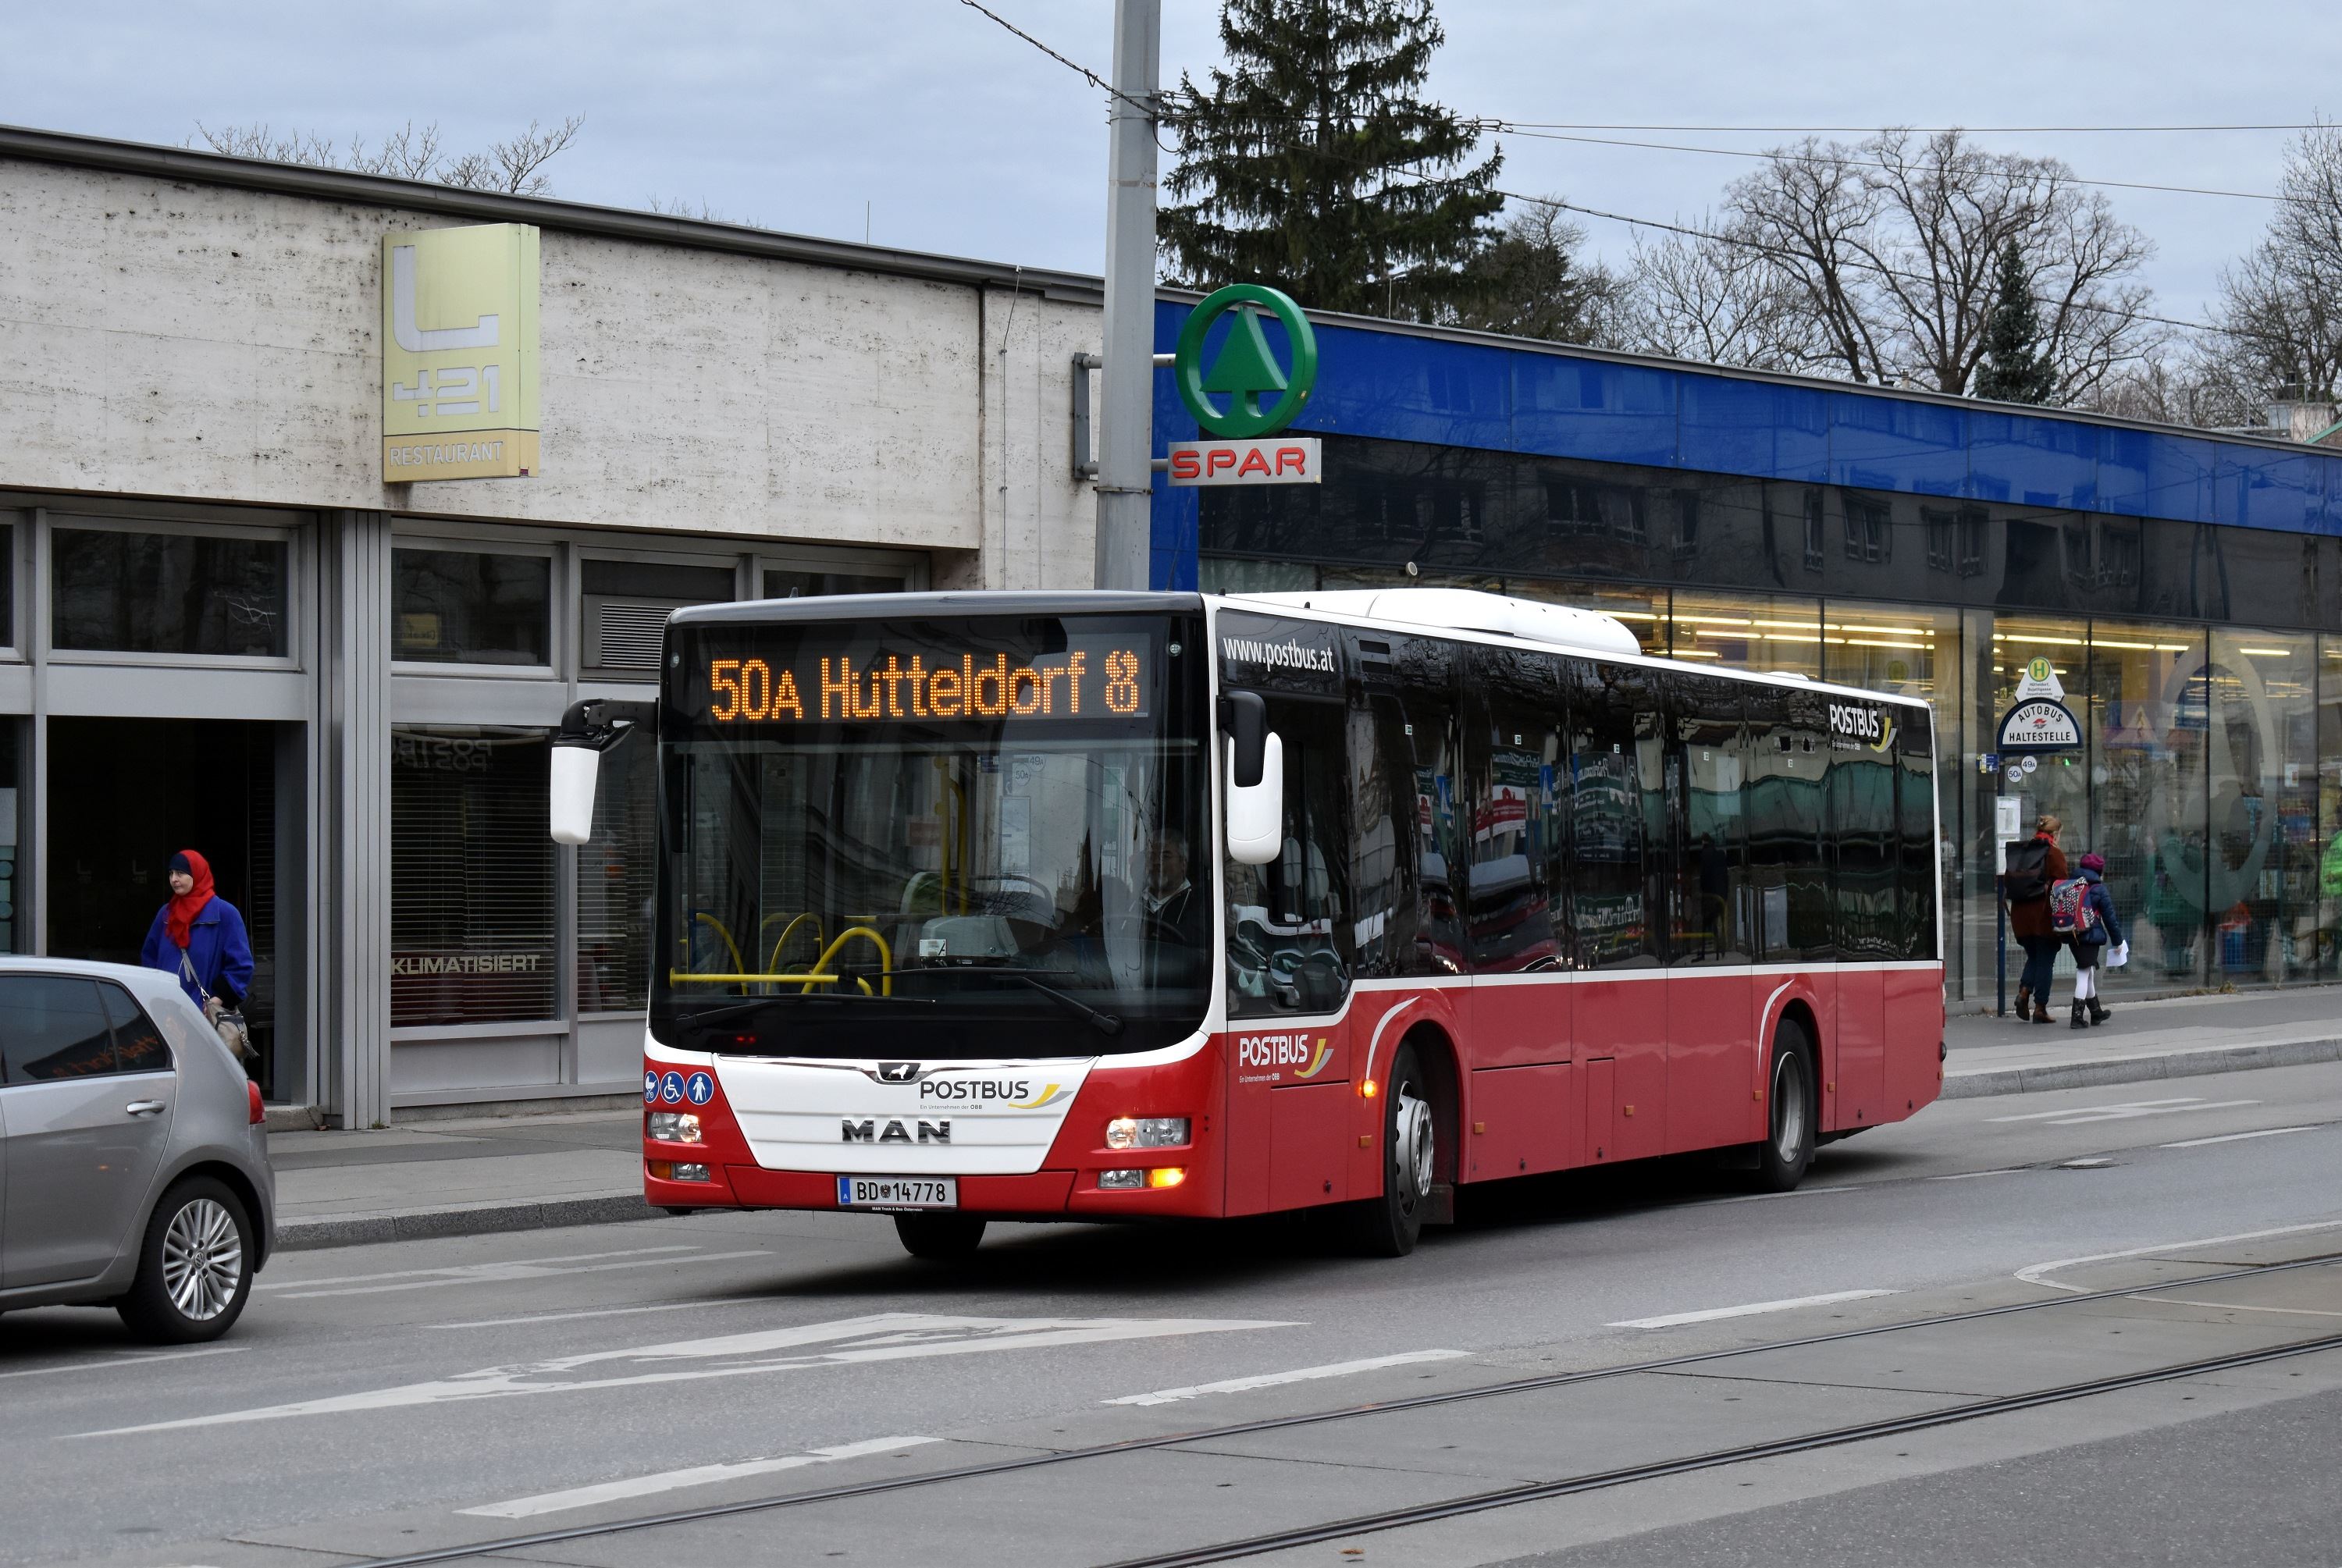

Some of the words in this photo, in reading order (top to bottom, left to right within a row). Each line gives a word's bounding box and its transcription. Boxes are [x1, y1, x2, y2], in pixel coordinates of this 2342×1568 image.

[393, 364, 500, 418] 421
[390, 441, 504, 467] RESTAURANT
[1172, 447, 1305, 478] SPAR
[1223, 638, 1334, 672] www.postbus.at
[2034, 662, 2045, 677] H
[711, 659, 803, 720] 50A
[1829, 704, 1879, 738] POSTBUS
[2017, 706, 2063, 723] AUTOBUS
[2009, 732, 2070, 741] HALTESTELLE
[1030, 756, 1044, 765] 49A
[390, 955, 540, 975] KLIMATISIERT
[1240, 1034, 1308, 1067] POSTBUS
[920, 1080, 1029, 1099] POSTBUS
[842, 1117, 952, 1143] MAN
[857, 1182, 878, 1200] BD
[892, 1182, 946, 1201] 14778
